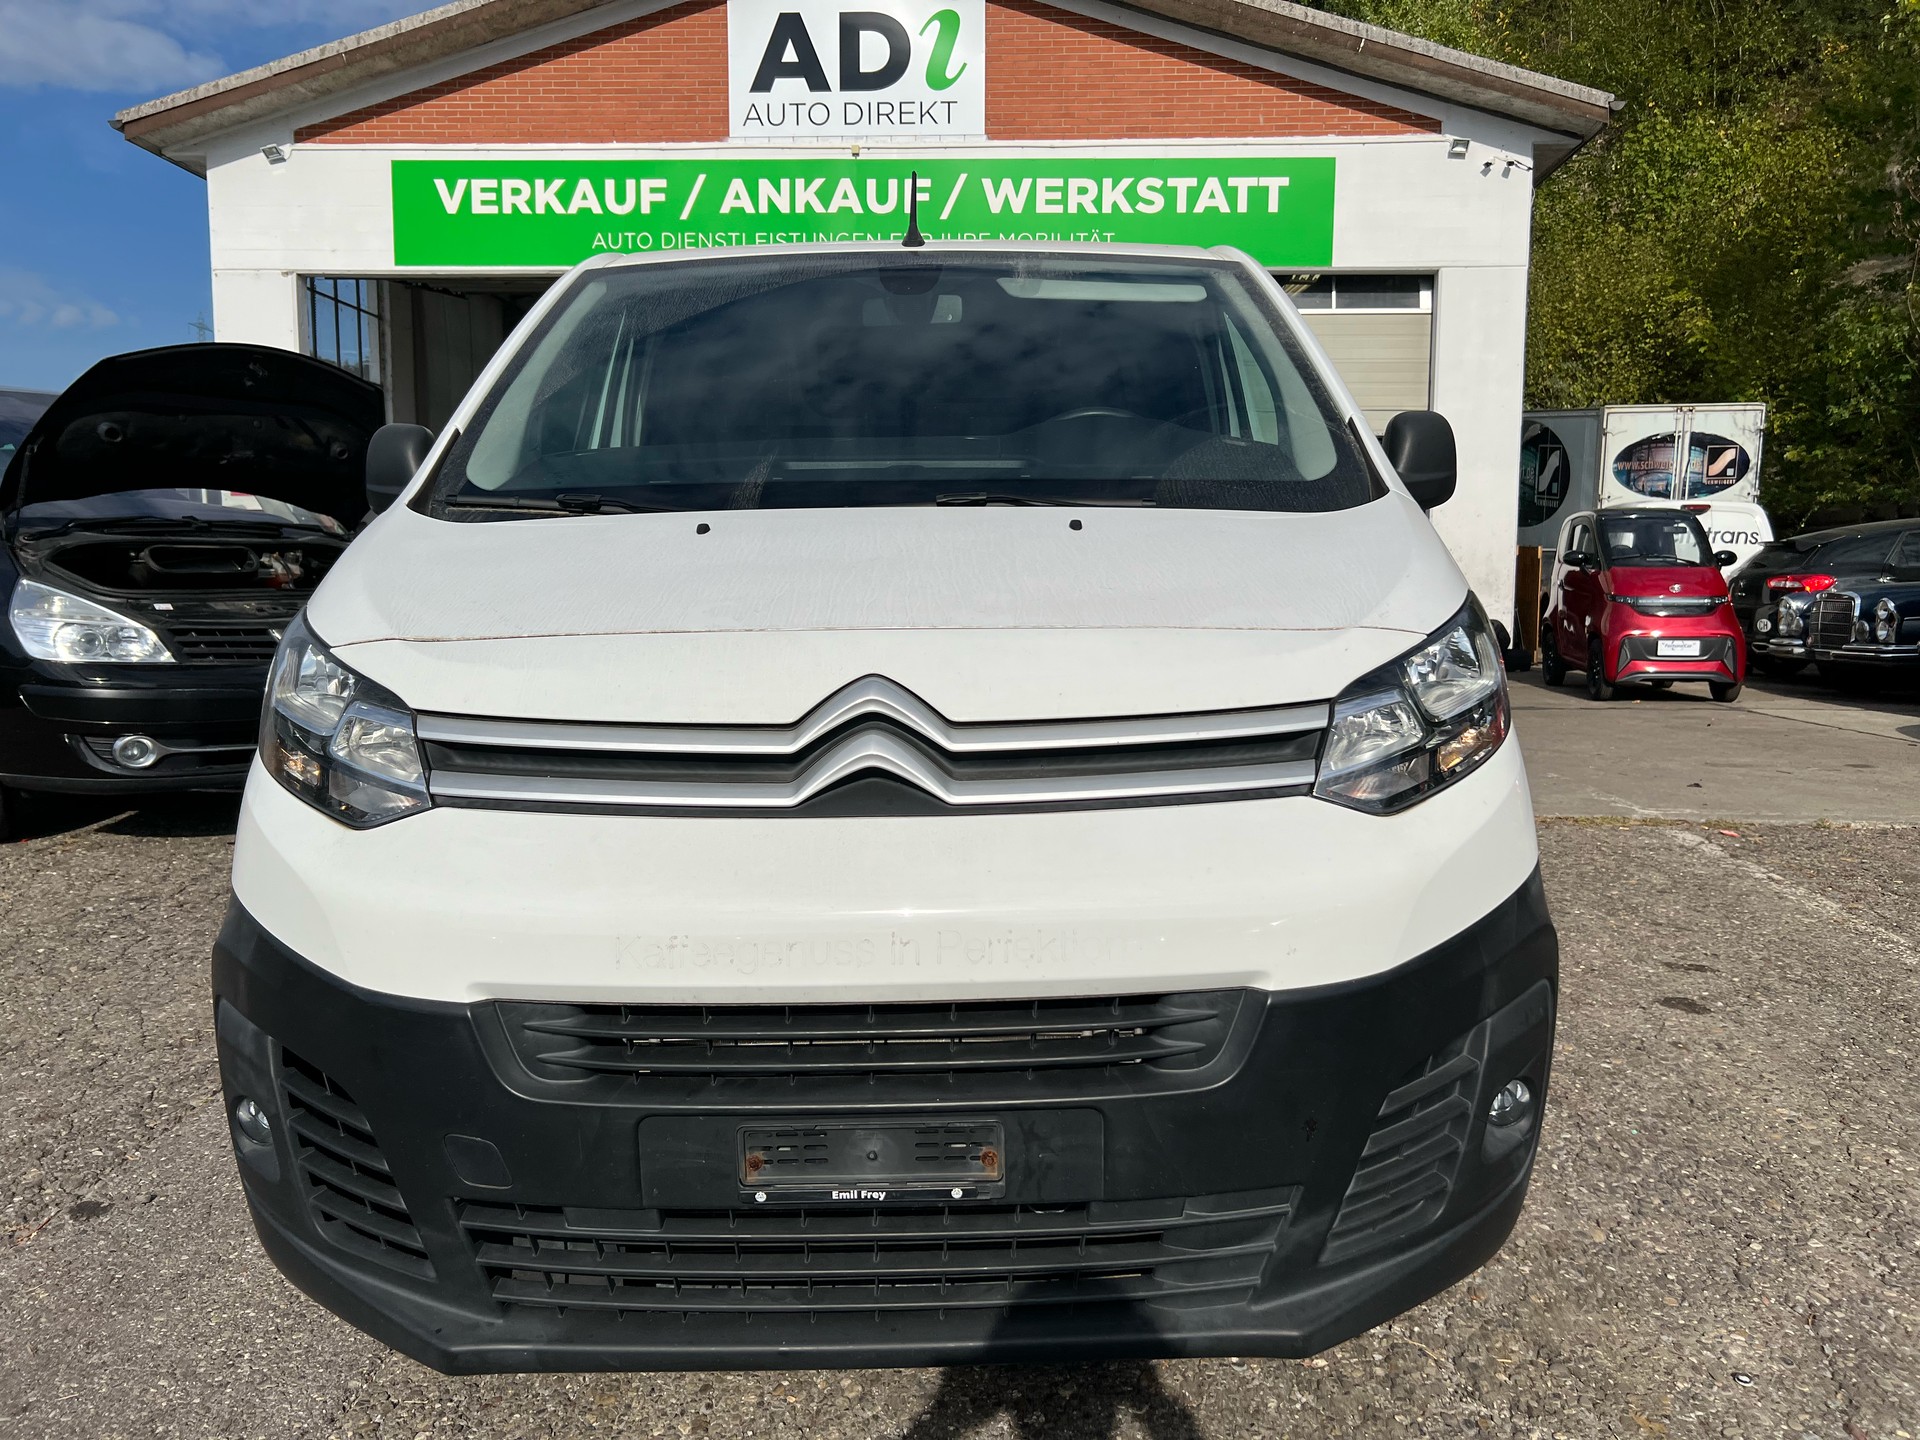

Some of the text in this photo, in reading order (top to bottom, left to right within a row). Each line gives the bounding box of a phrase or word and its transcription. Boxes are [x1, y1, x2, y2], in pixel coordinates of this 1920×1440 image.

[743, 101, 958, 127] AUTO DIREKT
[433, 173, 1290, 220] VERKAUF / ANKAUF / WERKSTATT
[591, 232, 653, 249] AUTO
[1758, 620, 1768, 631] CH
[832, 1190, 887, 1201] Emil Frey
